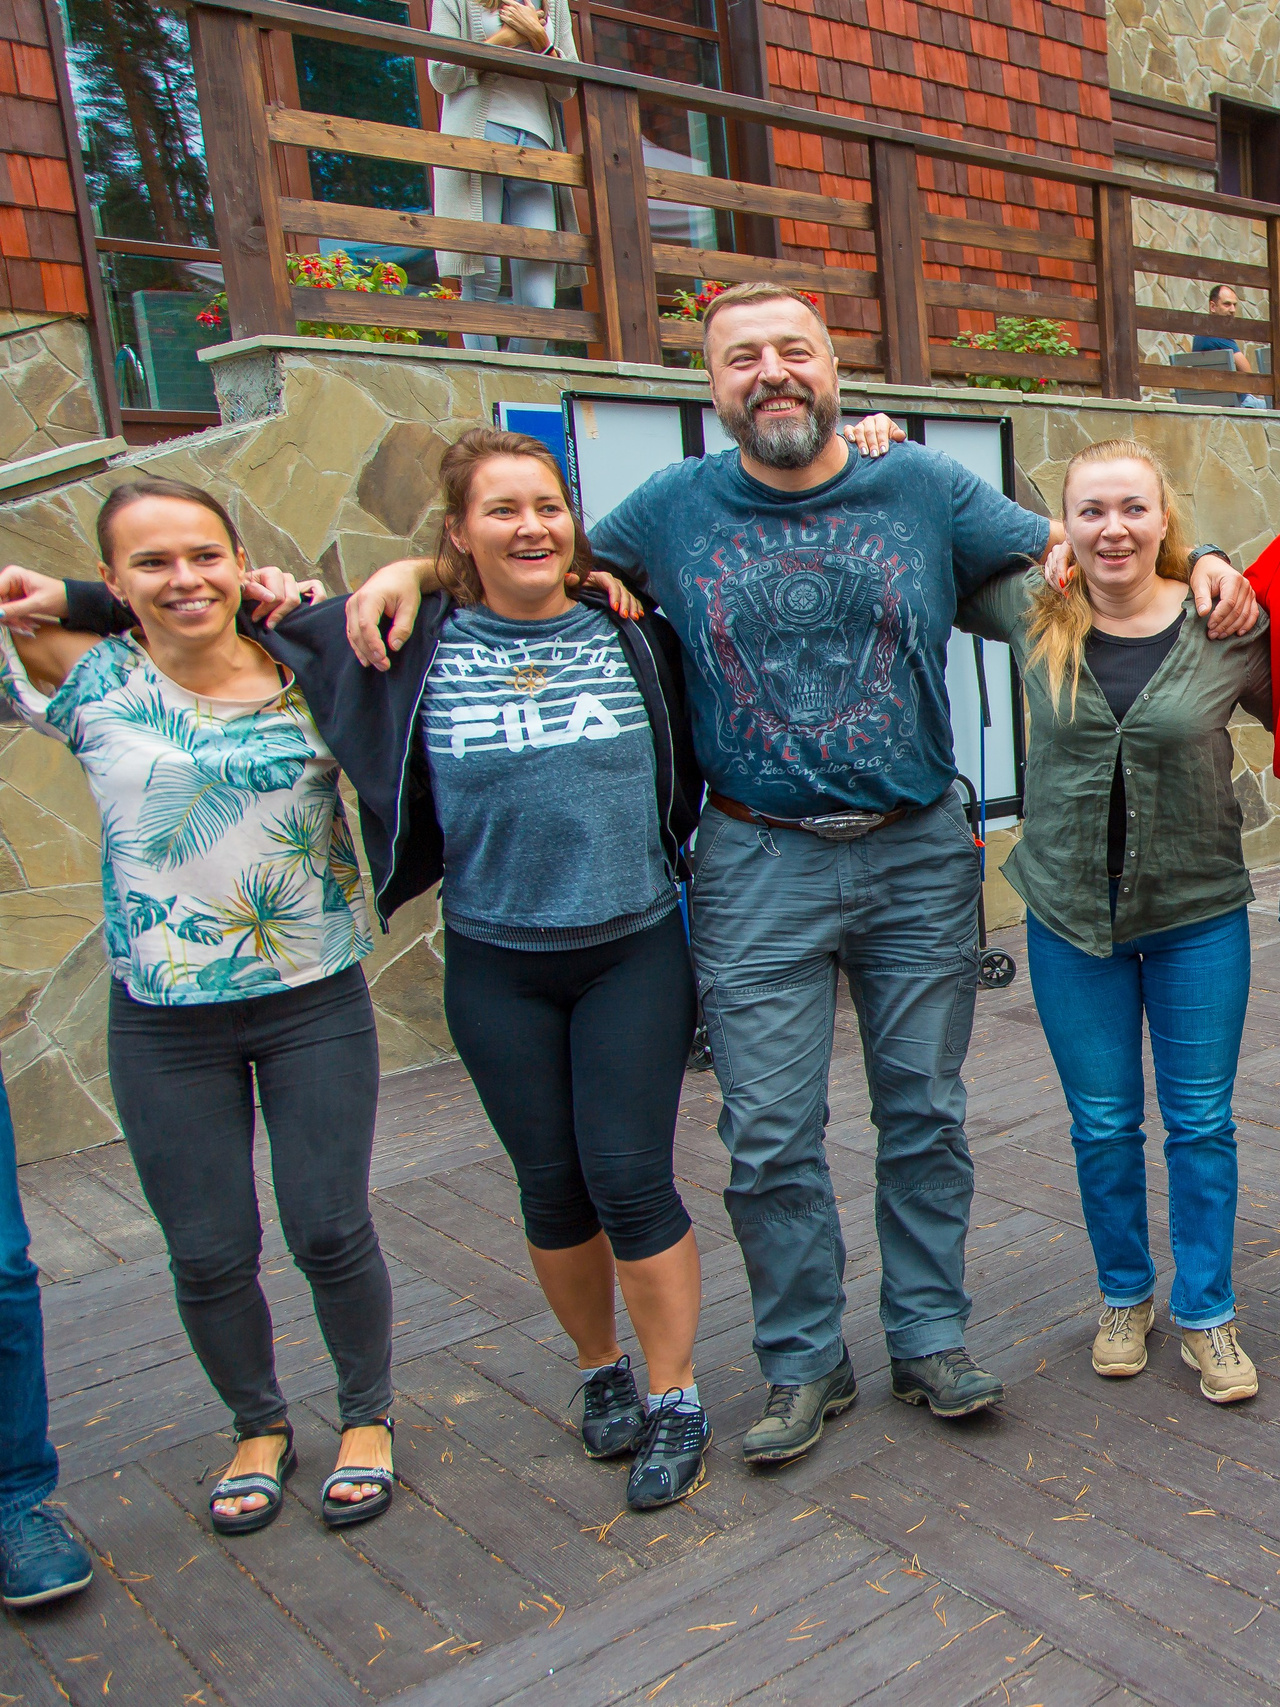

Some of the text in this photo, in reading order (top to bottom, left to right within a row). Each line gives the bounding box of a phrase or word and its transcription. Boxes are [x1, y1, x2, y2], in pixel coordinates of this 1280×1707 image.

[567, 435, 577, 483] outdoor
[694, 515, 909, 601] AFFLICTION
[438, 638, 531, 683] YACHT
[450, 692, 621, 758] FILA
[759, 760, 785, 775] Los
[787, 763, 851, 782] Angeles
